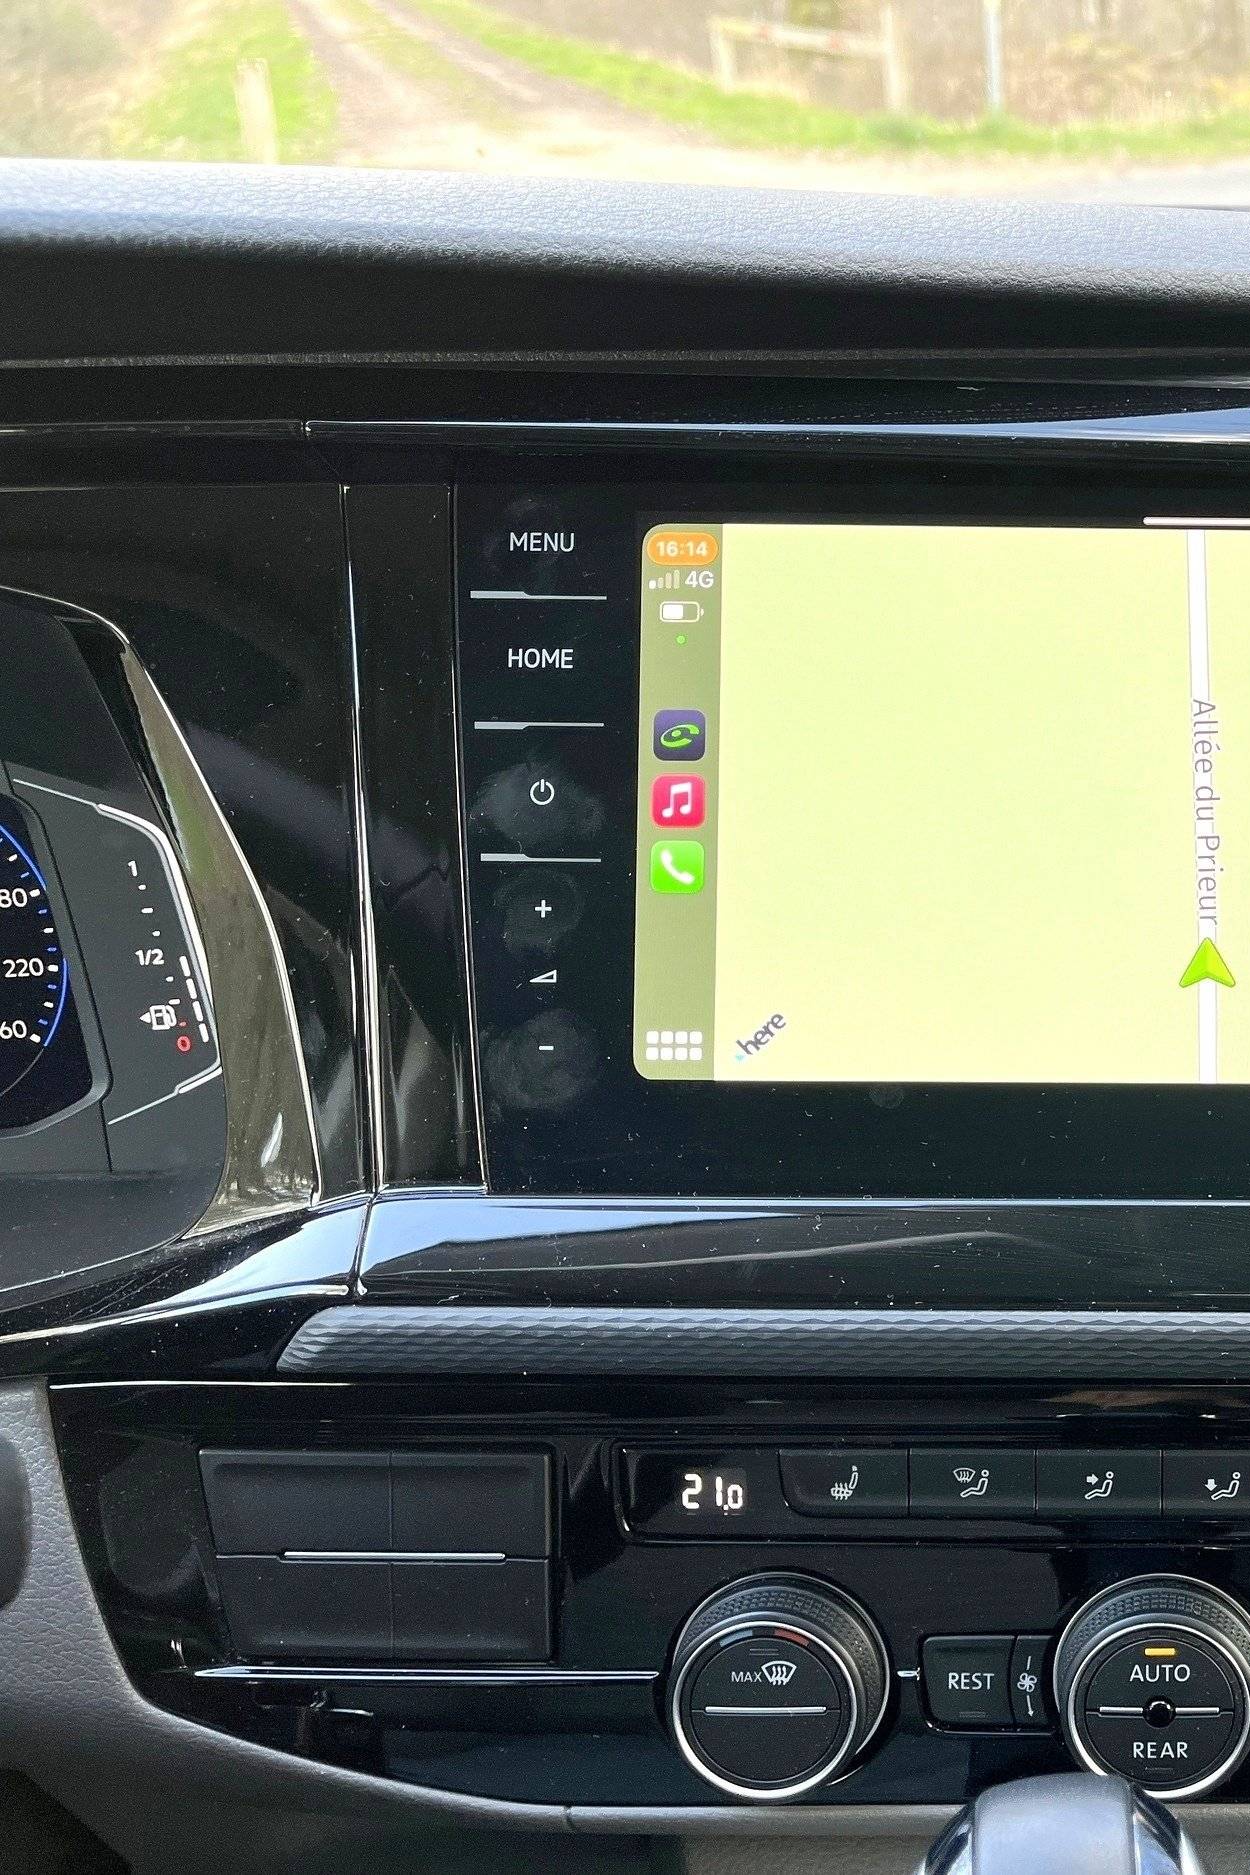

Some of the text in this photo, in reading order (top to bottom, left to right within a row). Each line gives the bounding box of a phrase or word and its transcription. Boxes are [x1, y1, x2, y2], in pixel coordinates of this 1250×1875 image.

[509, 532, 575, 552] MENU
[656, 541, 708, 556] 16:14
[684, 571, 714, 588] 4G
[507, 648, 574, 669] HOME
[1193, 699, 1224, 926] Allée du Prieur
[128, 860, 138, 877] 1
[135, 949, 165, 966] 1/2
[2, 957, 44, 978] 220
[176, 1034, 192, 1052] 0
[735, 1013, 786, 1055] here
[731, 1671, 762, 1683] MAX
[947, 1671, 995, 1691] REST
[1129, 1663, 1191, 1683] AUTO
[1133, 1741, 1188, 1760] REAR
